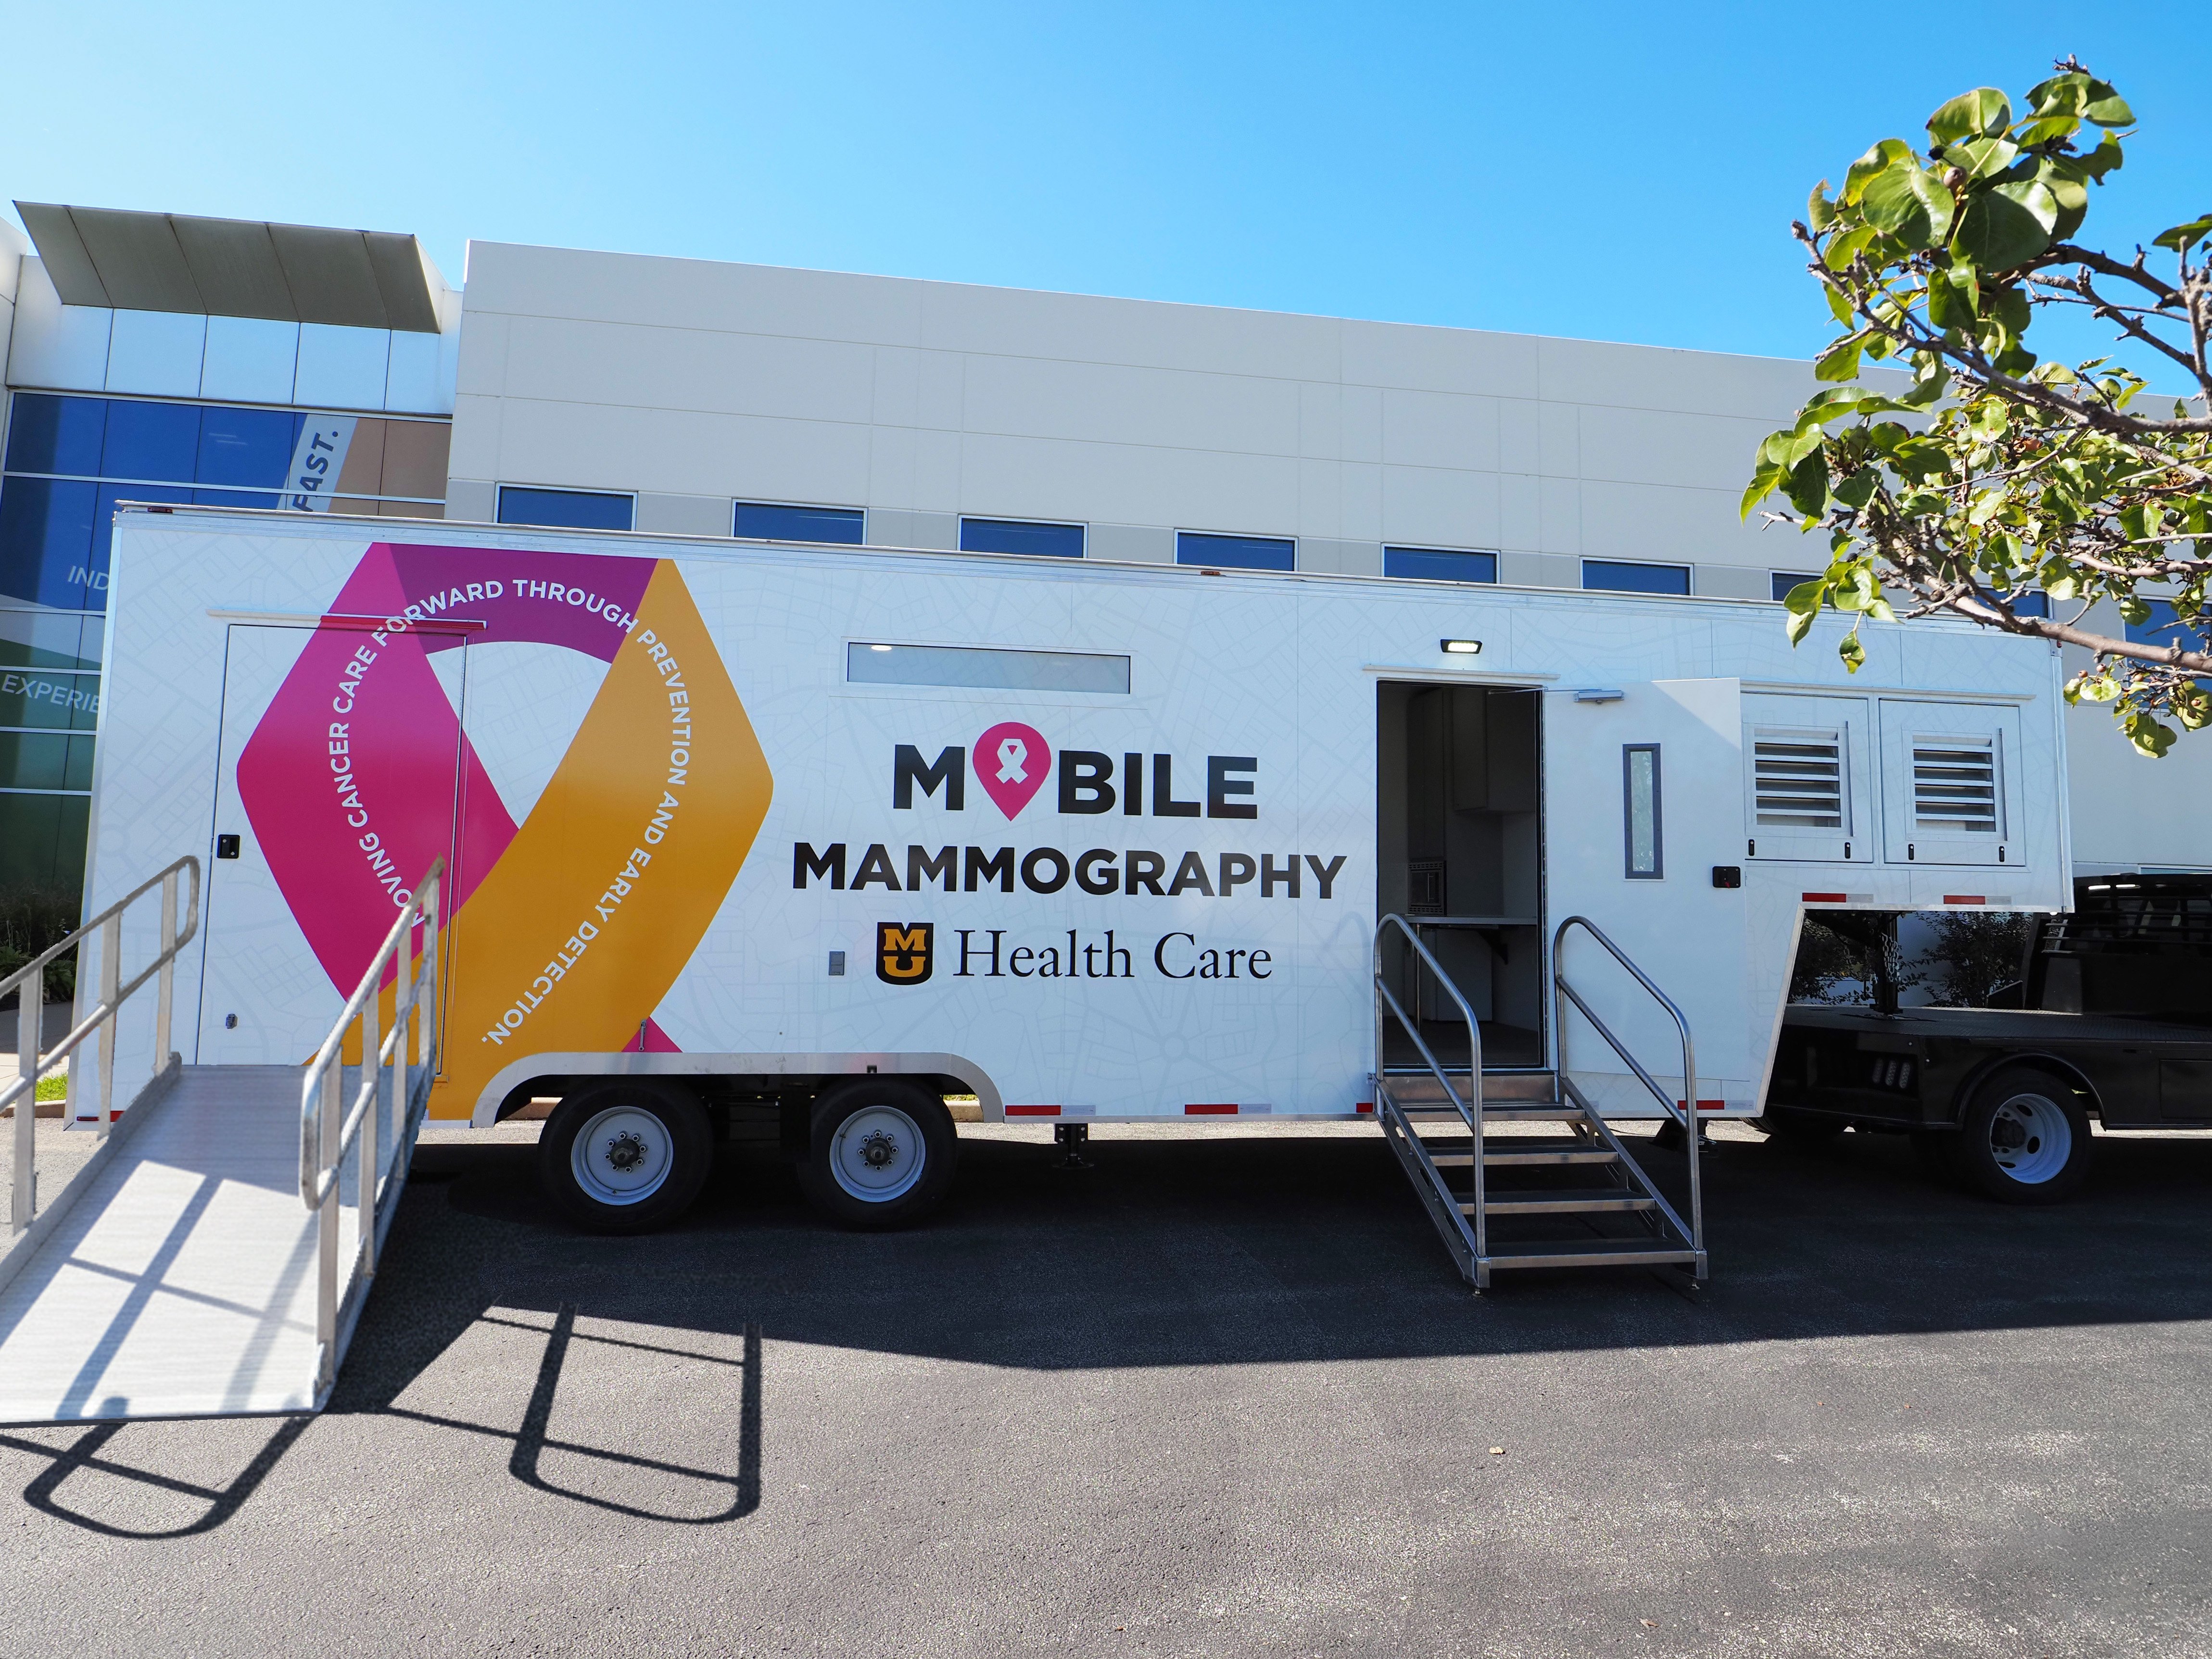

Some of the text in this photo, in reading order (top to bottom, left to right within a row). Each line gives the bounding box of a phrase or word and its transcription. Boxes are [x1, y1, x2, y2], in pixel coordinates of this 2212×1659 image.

[292, 431, 338, 512] FAST.
[371, 580, 504, 647] FORWARD
[513, 579, 639, 634] THROUGH
[333, 645, 378, 714] CARE
[636, 629, 691, 785] PREVENTION
[329, 722, 368, 828] CANCER
[644, 790, 679, 844] AND
[594, 847, 652, 922] EARLY
[793, 842, 1347, 899] MAMMOGRAPHY
[481, 920, 599, 1045] DETECTION.
[953, 929, 1135, 978] Health
[1155, 932, 1272, 979] Care
